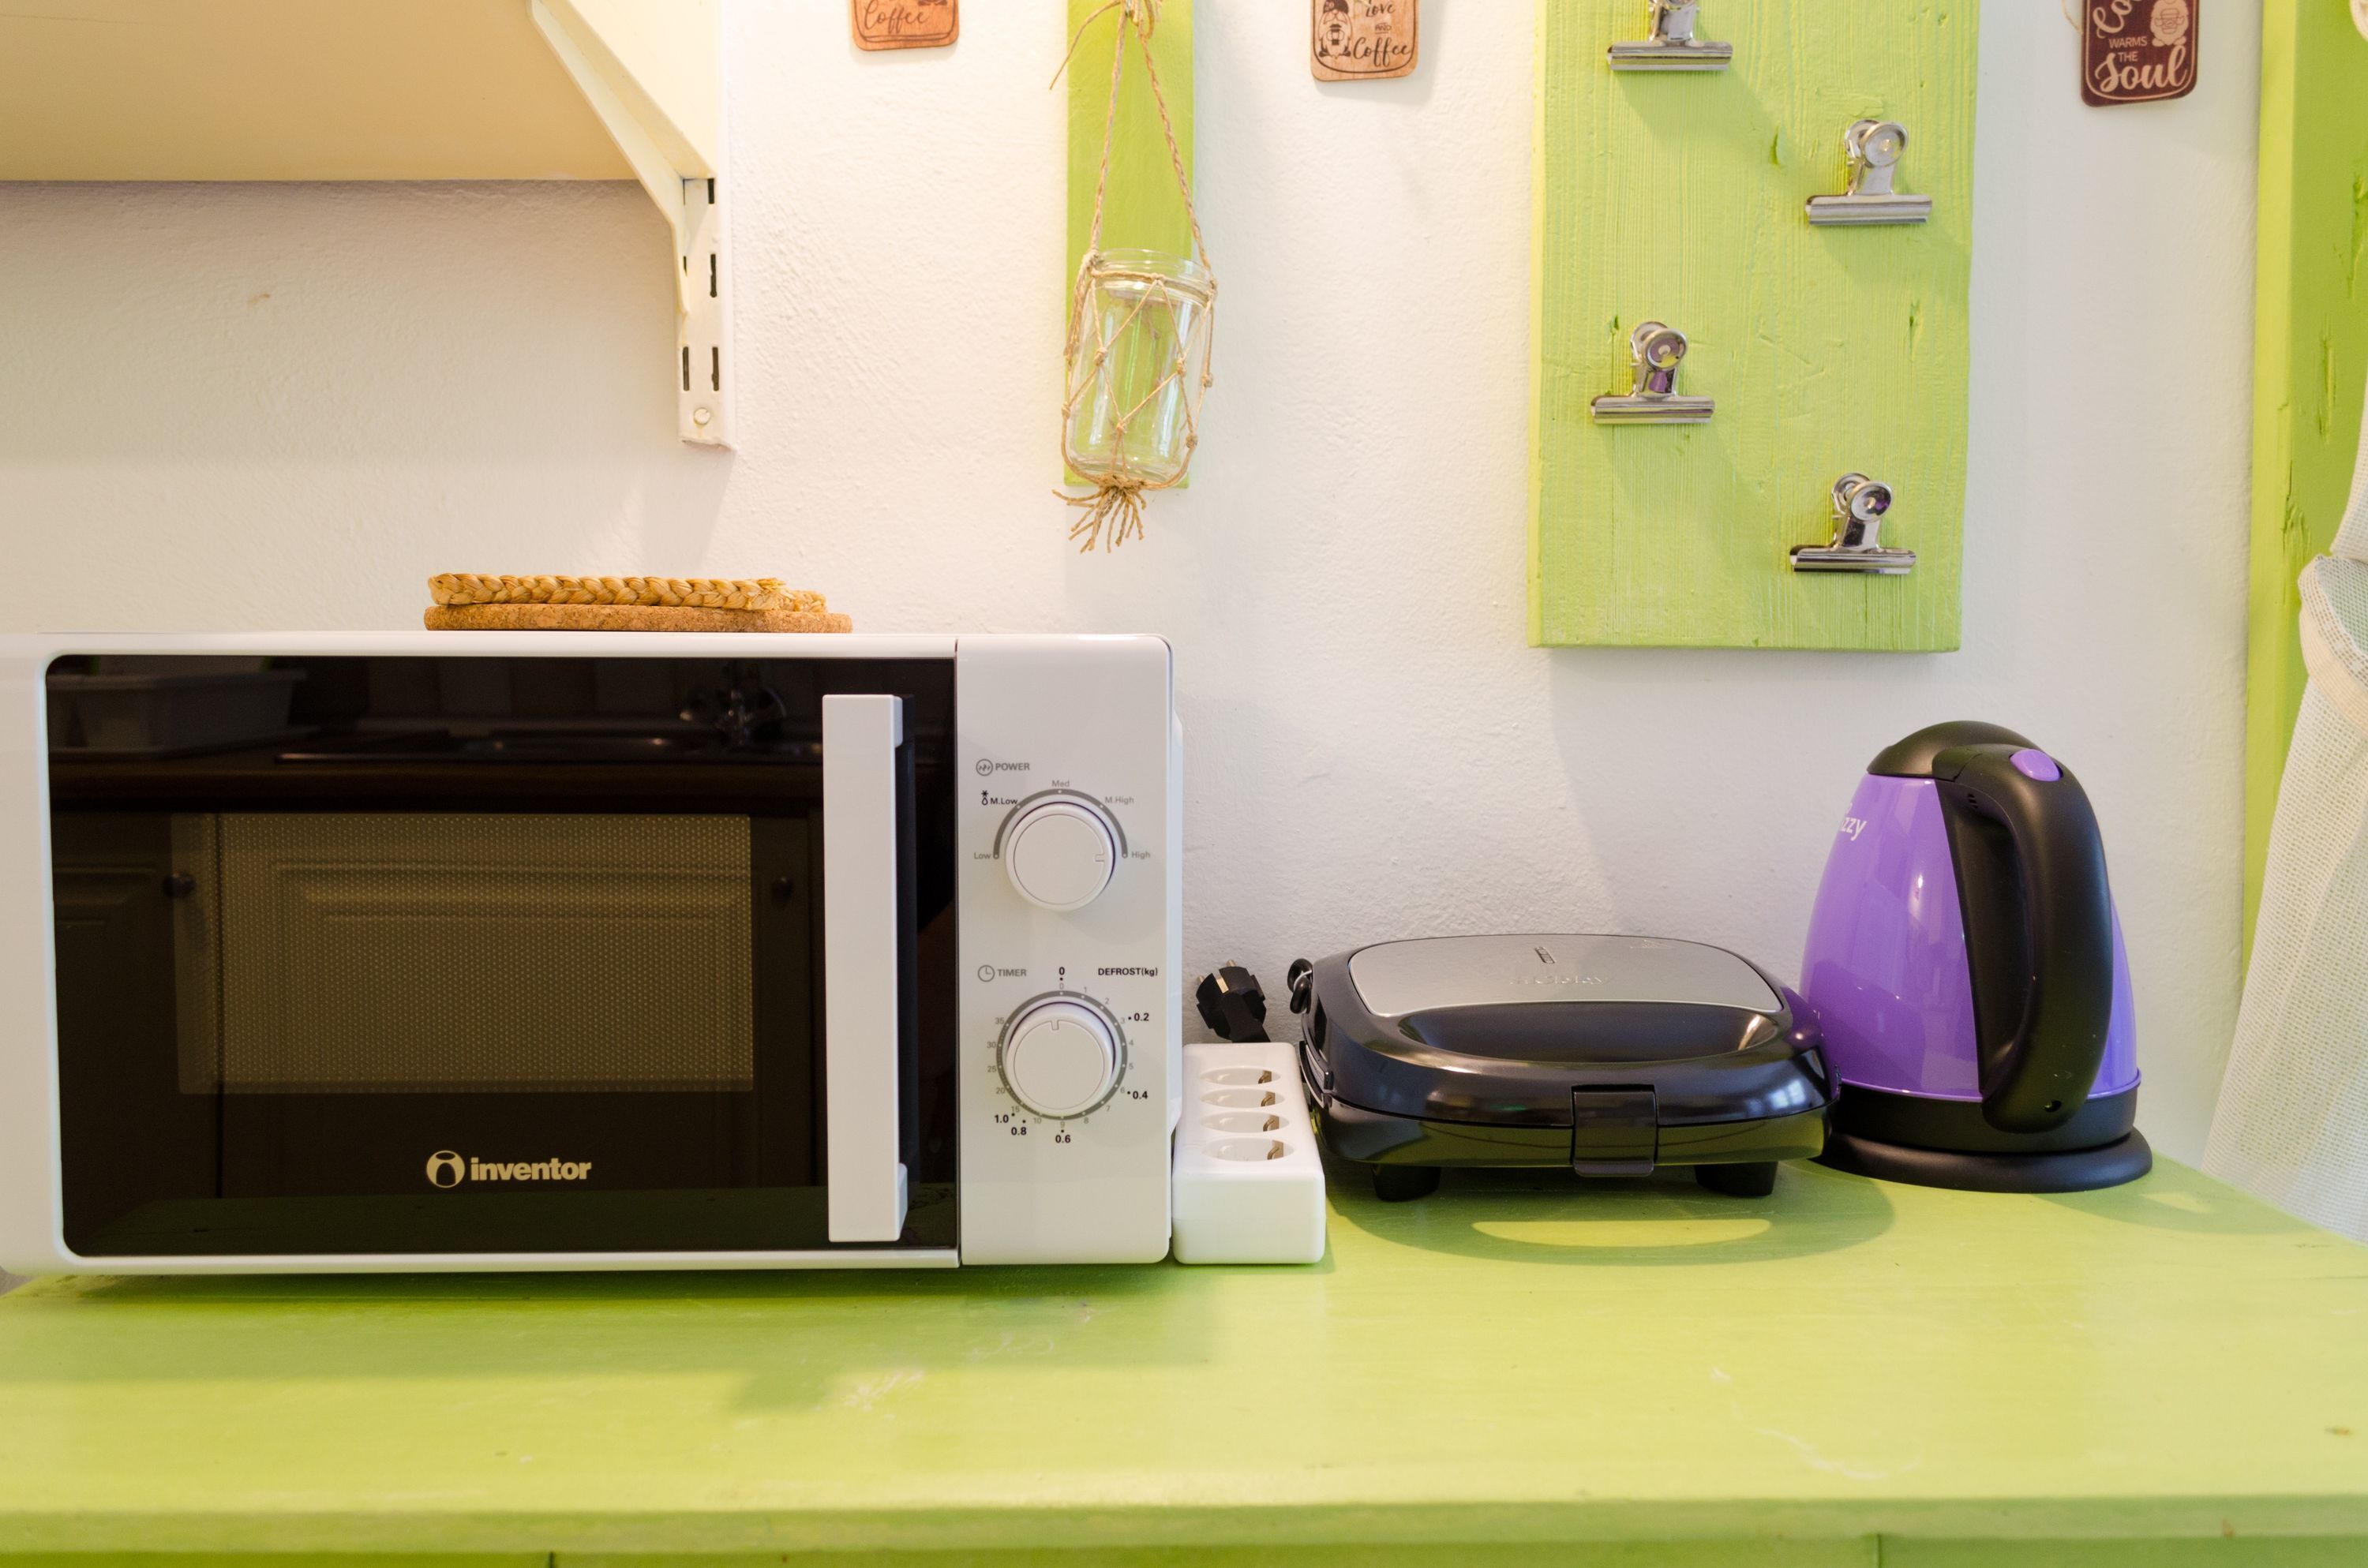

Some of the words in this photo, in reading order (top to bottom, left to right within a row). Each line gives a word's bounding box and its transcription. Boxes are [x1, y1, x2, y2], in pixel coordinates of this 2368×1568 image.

[864, 0, 928, 34] Coffee
[2108, 36, 2148, 48] WARMS
[1353, 37, 1411, 67] Coffee
[2118, 51, 2139, 62] THE
[2094, 45, 2188, 92] Soul
[995, 762, 1030, 771] POWER
[990, 797, 1018, 806] M.Low
[1104, 796, 1134, 805] M.High
[997, 968, 1027, 977] TIMER
[1058, 966, 1066, 976] 0
[1098, 967, 1158, 977] DEFROST(kg)
[1133, 1012, 1149, 1022] 0.2
[987, 1065, 997, 1073] 25
[1132, 1091, 1148, 1100] 0.4
[1011, 1105, 1021, 1113] 15
[995, 1114, 1010, 1124] 1.0
[1010, 1126, 1027, 1136] 0.8
[1055, 1134, 1071, 1143] 0.6
[470, 1157, 591, 1181] inventor
